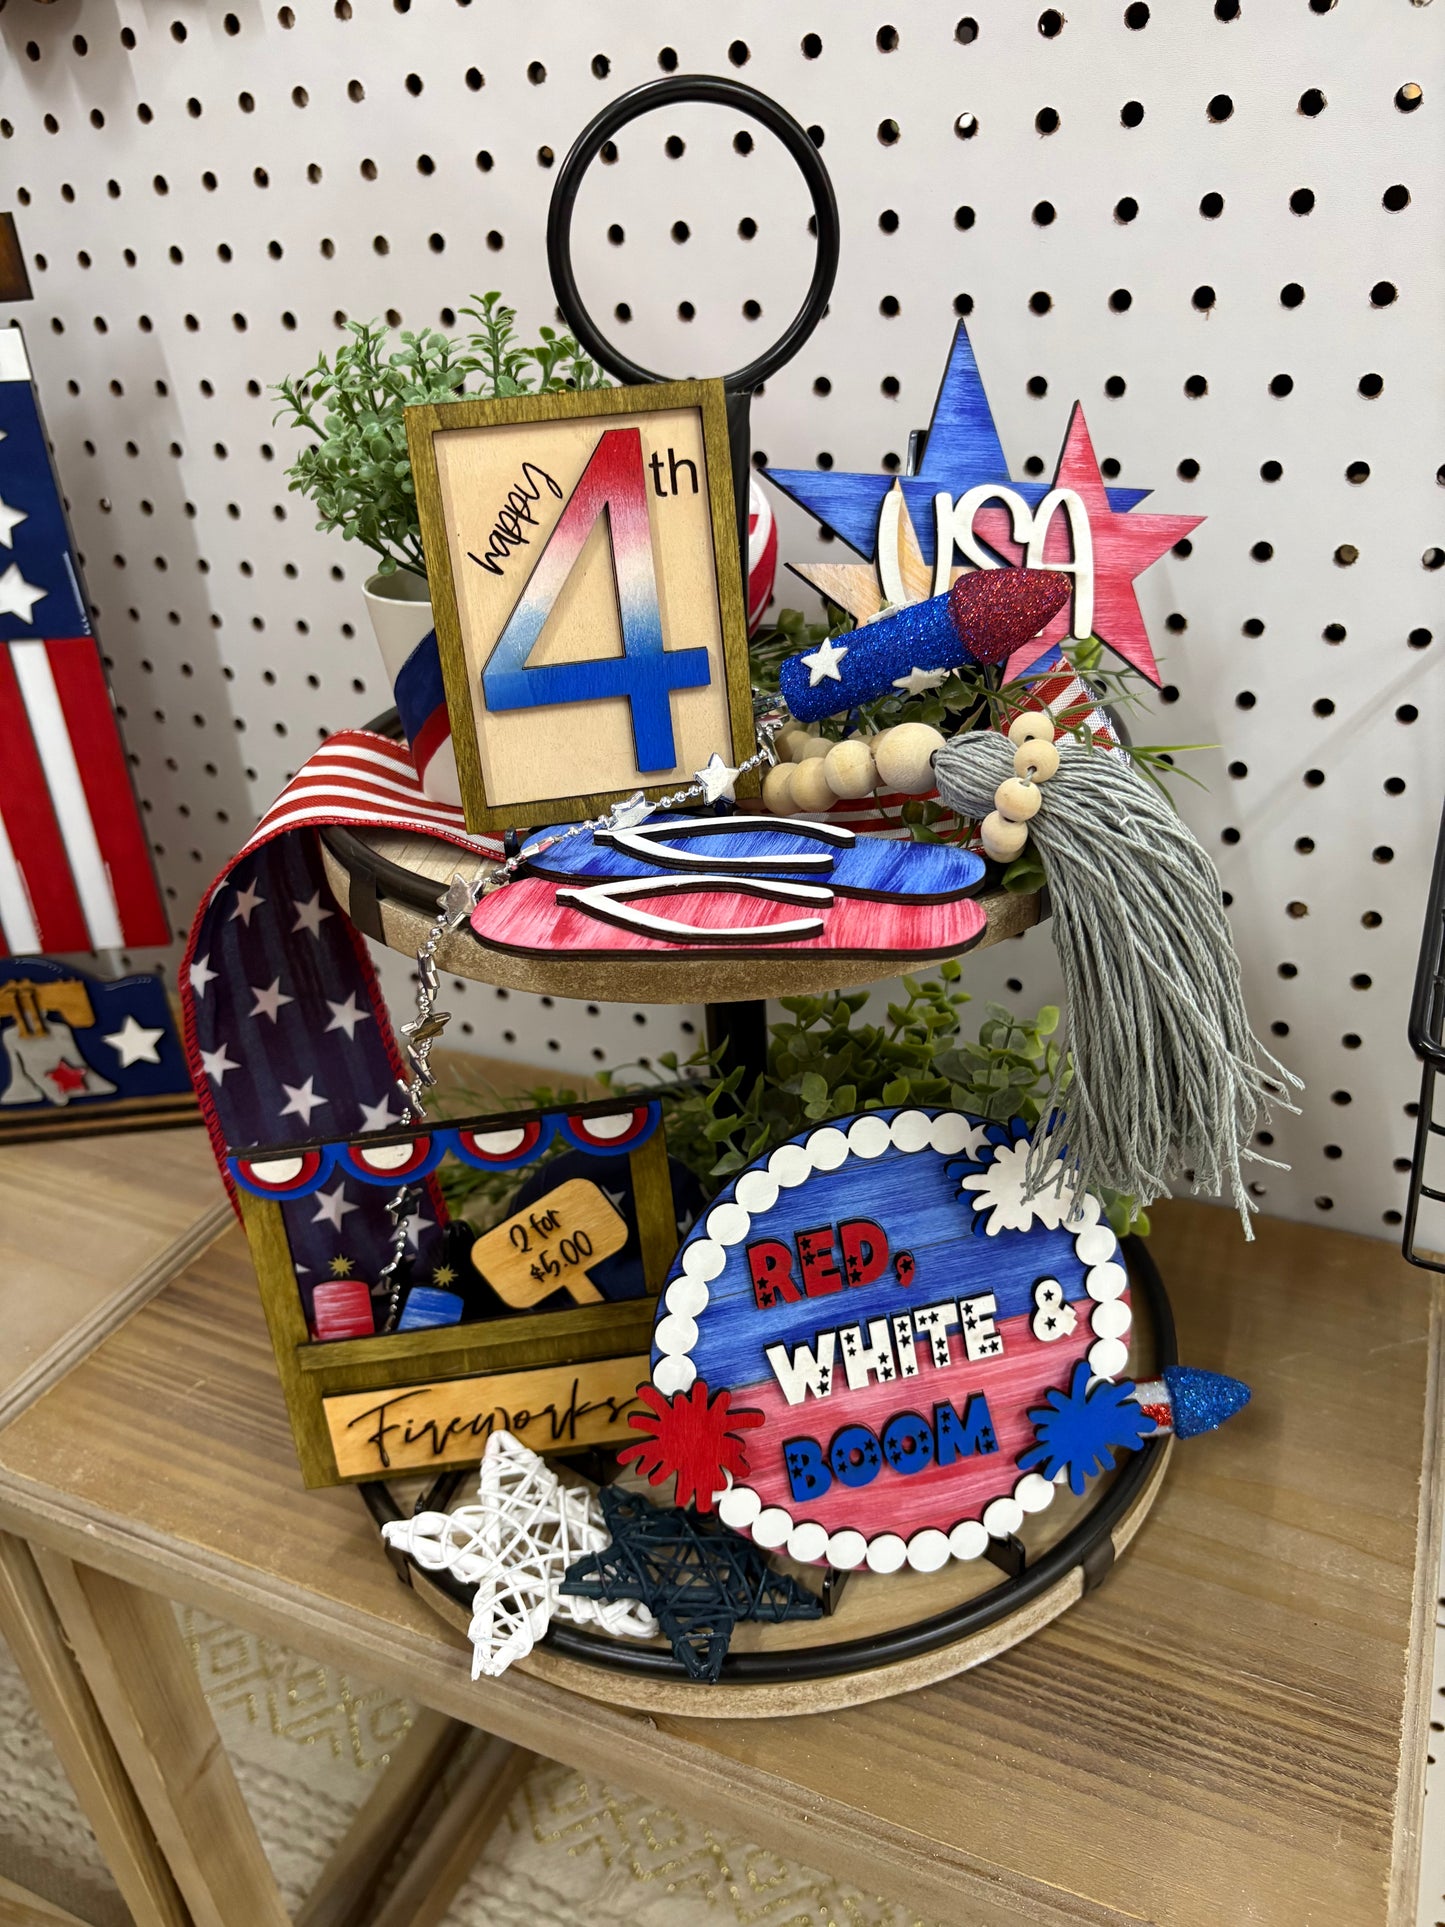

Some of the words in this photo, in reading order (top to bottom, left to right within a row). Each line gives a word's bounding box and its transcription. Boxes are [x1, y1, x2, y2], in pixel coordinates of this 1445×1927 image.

[467, 462, 563, 575] happy
[877, 484, 1094, 640] USA
[510, 1224, 532, 1253] 2
[529, 1209, 561, 1239] for
[529, 1230, 593, 1283] $5.00
[745, 1217, 916, 1310] RED,
[763, 1289, 1004, 1406] WHITE
[1031, 1277, 1079, 1342] &
[347, 1378, 640, 1468] Fireworks
[782, 1391, 1000, 1502] BOOM
